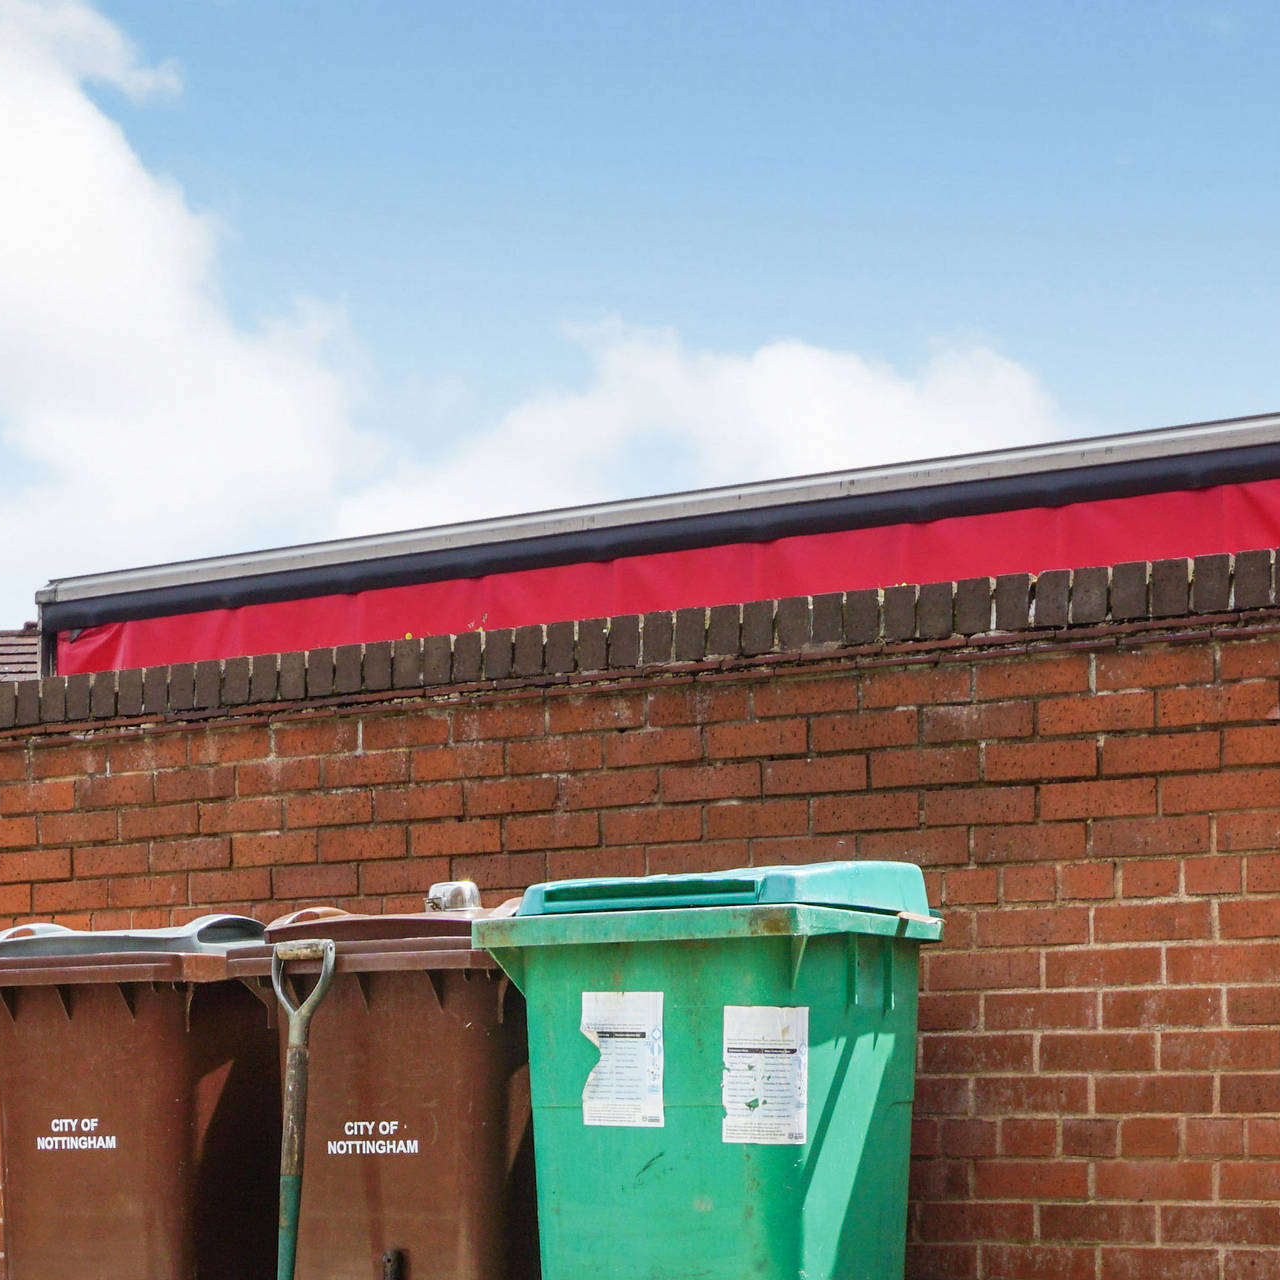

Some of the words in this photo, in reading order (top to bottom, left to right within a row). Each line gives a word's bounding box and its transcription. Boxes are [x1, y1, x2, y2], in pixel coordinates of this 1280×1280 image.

[51, 1119, 78, 1132] CITY
[81, 1118, 98, 1131] OF
[344, 1121, 375, 1135] CITY
[378, 1121, 398, 1135] OF
[37, 1136, 116, 1149] NOTTINGHAM
[327, 1140, 419, 1154] NOTTINGHAM
